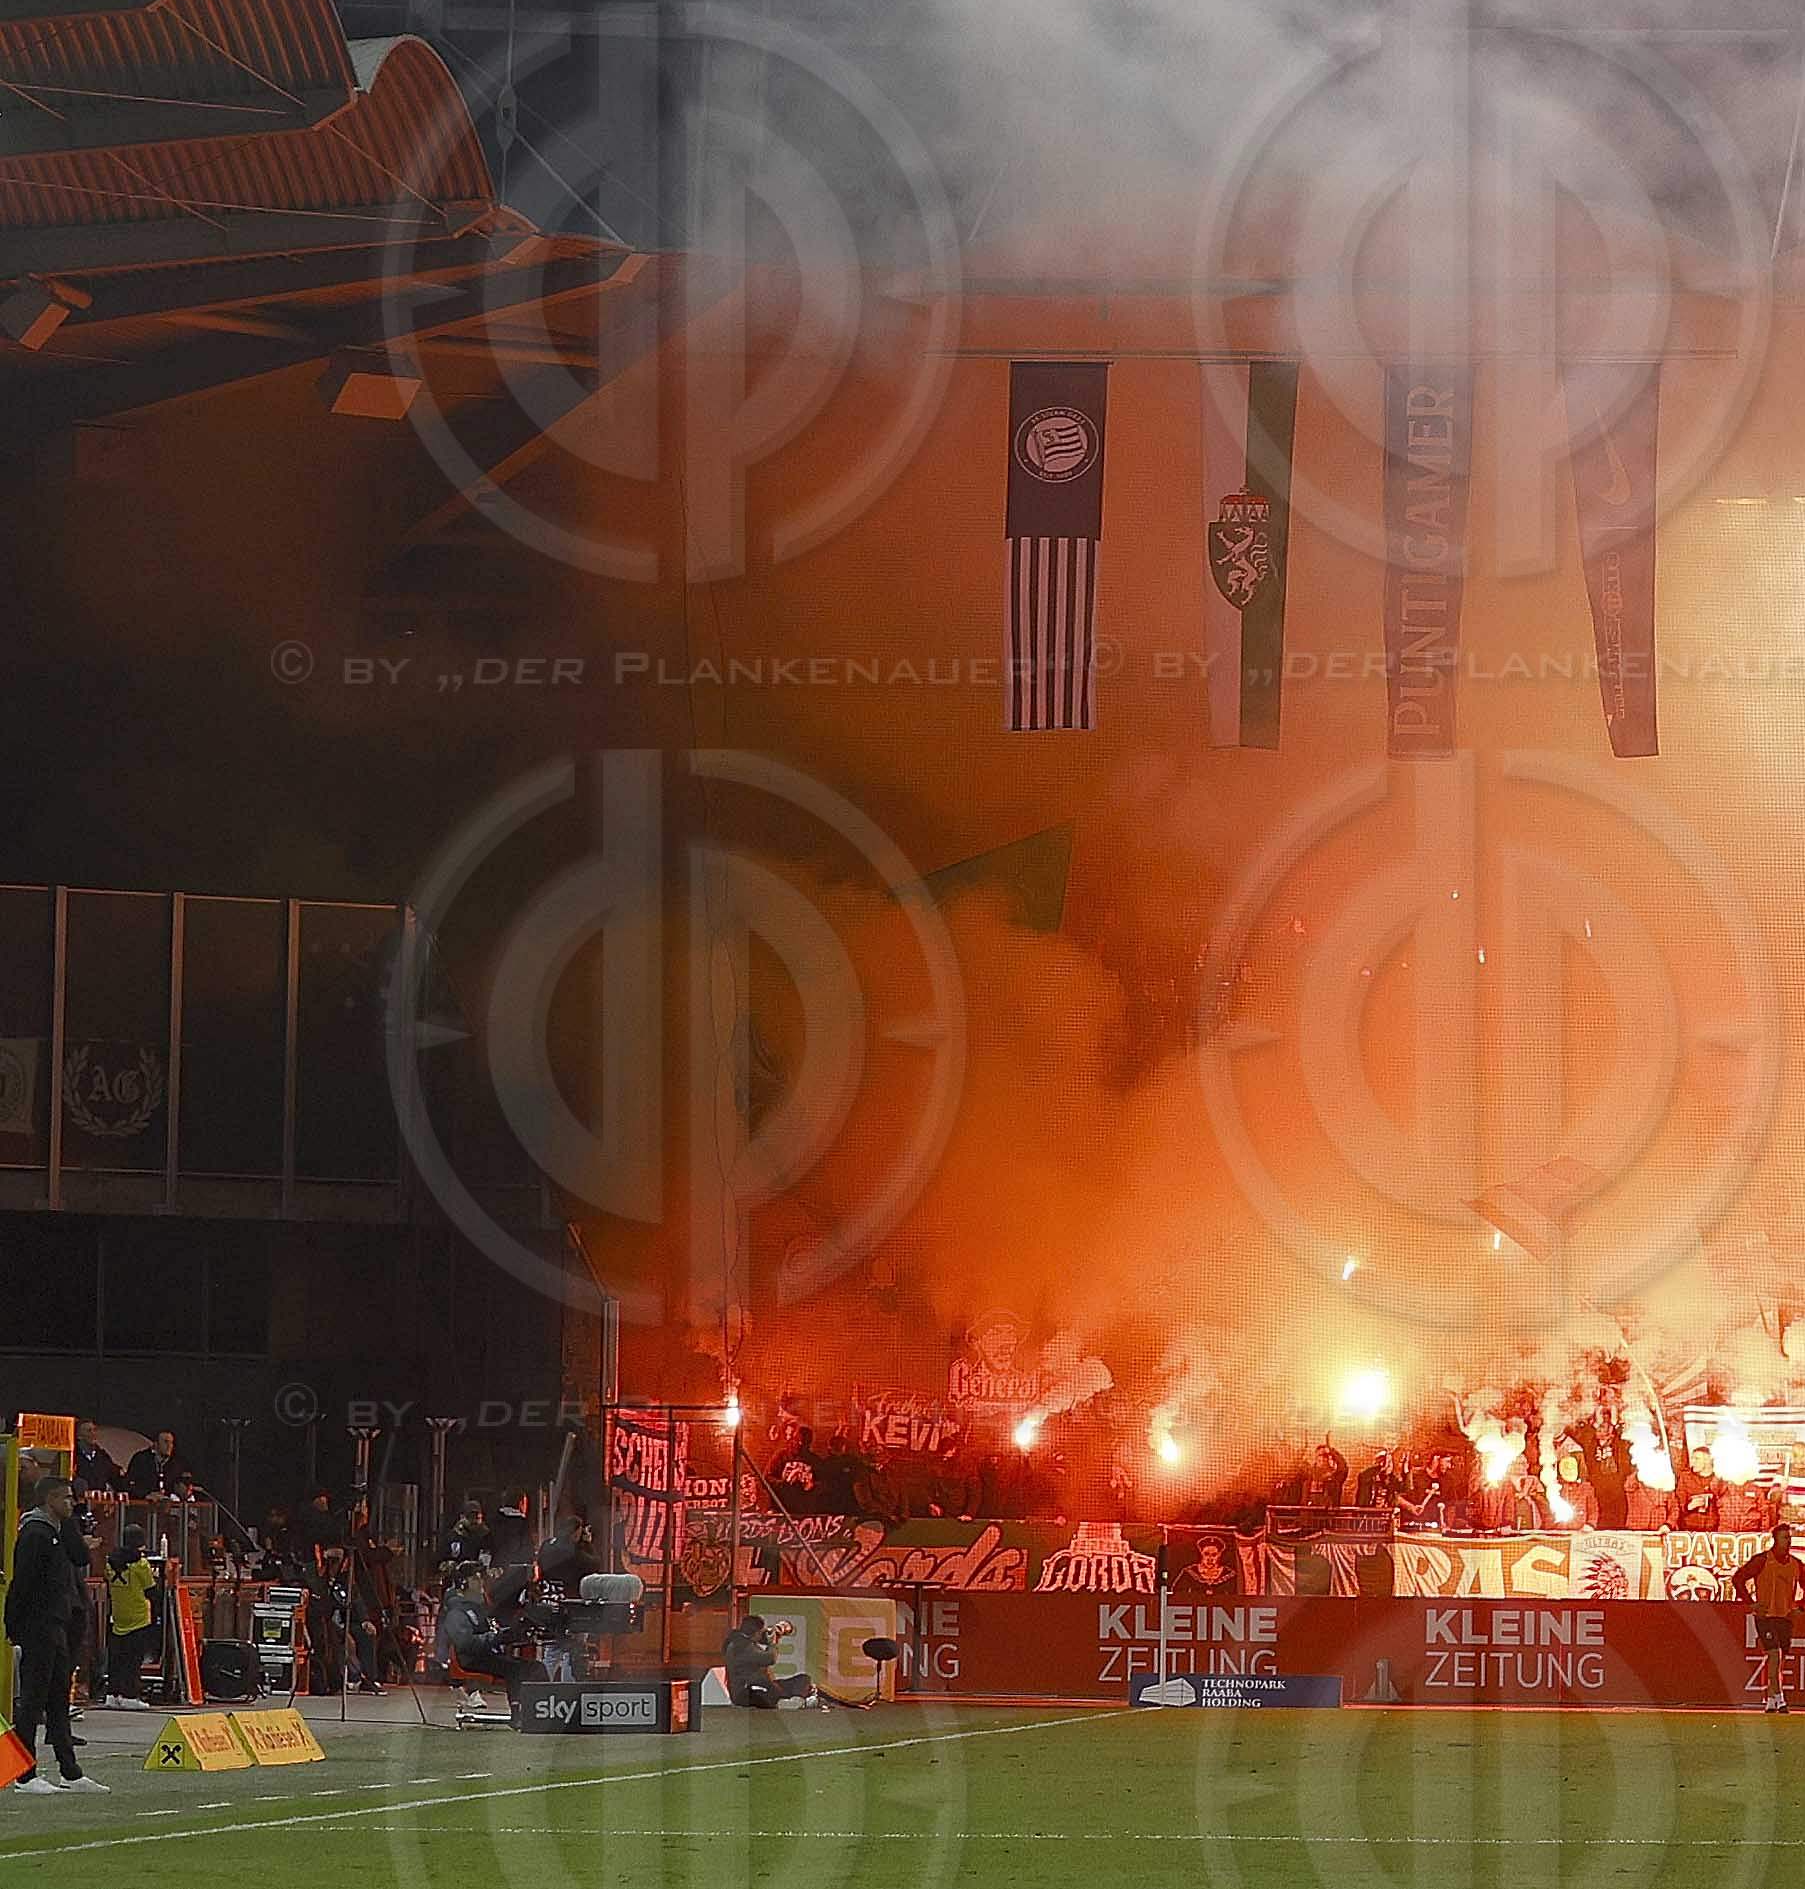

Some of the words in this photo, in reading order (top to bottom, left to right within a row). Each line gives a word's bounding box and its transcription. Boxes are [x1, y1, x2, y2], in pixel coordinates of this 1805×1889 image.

[1394, 384, 1456, 736] PUNTIGAMER
[1099, 1603, 1277, 1642] KLEINE
[1425, 1608, 1605, 1646] KLEINE
[1202, 1679, 1286, 1690] TECHNOPARK
[1424, 1651, 1605, 1689] ZEITUNG
[534, 1695, 578, 1724] sky
[586, 1696, 652, 1721] sport
[1202, 1688, 1242, 1698] RAABA
[1202, 1698, 1261, 1708] HOLDING
